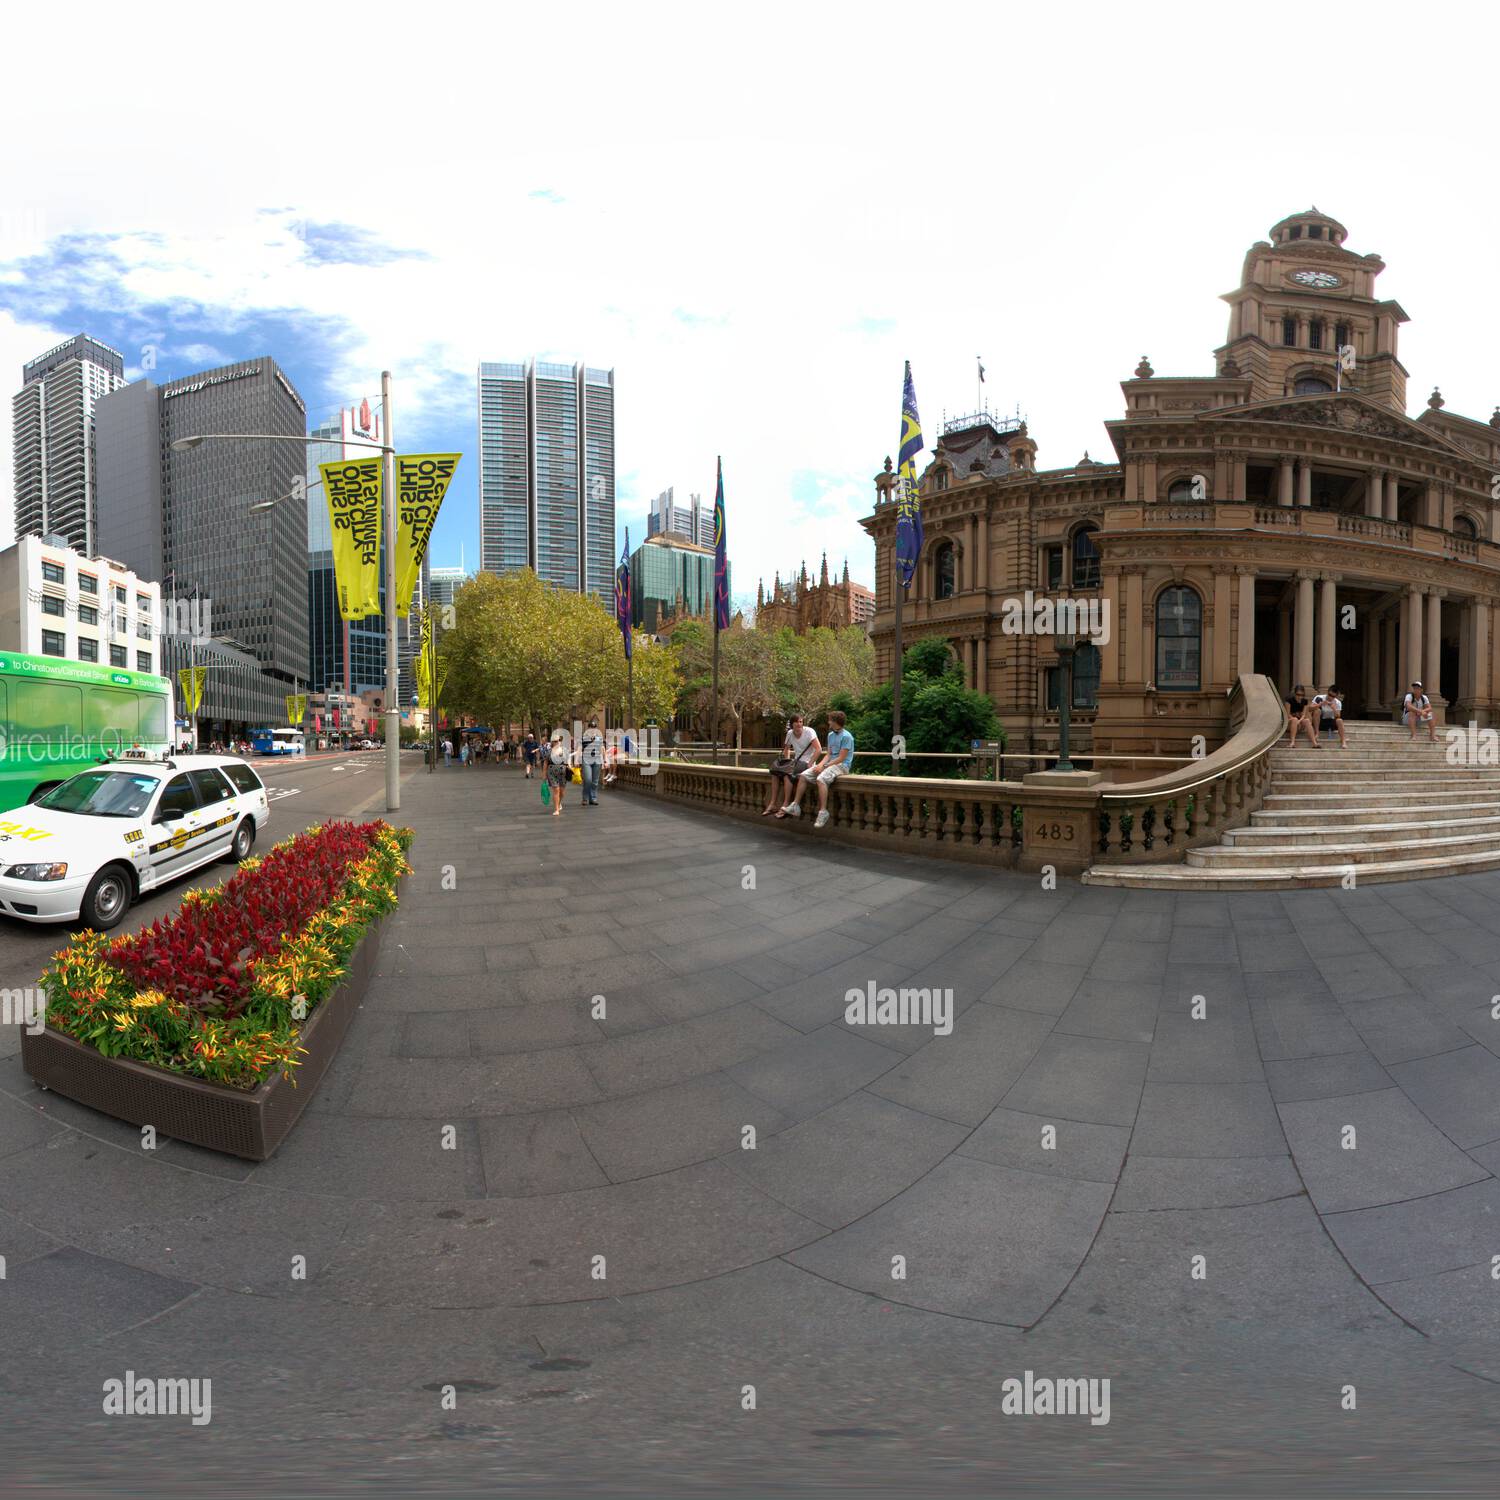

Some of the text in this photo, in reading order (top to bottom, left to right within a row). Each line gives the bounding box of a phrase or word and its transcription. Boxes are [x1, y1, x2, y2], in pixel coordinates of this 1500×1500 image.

[34, 339, 75, 364] MERITON
[164, 367, 260, 399] EnergyAustralia
[12, 660, 21, 670] to
[0, 723, 96, 763] ircular
[125, 751, 147, 759] TAXI
[1036, 823, 1074, 841] 483
